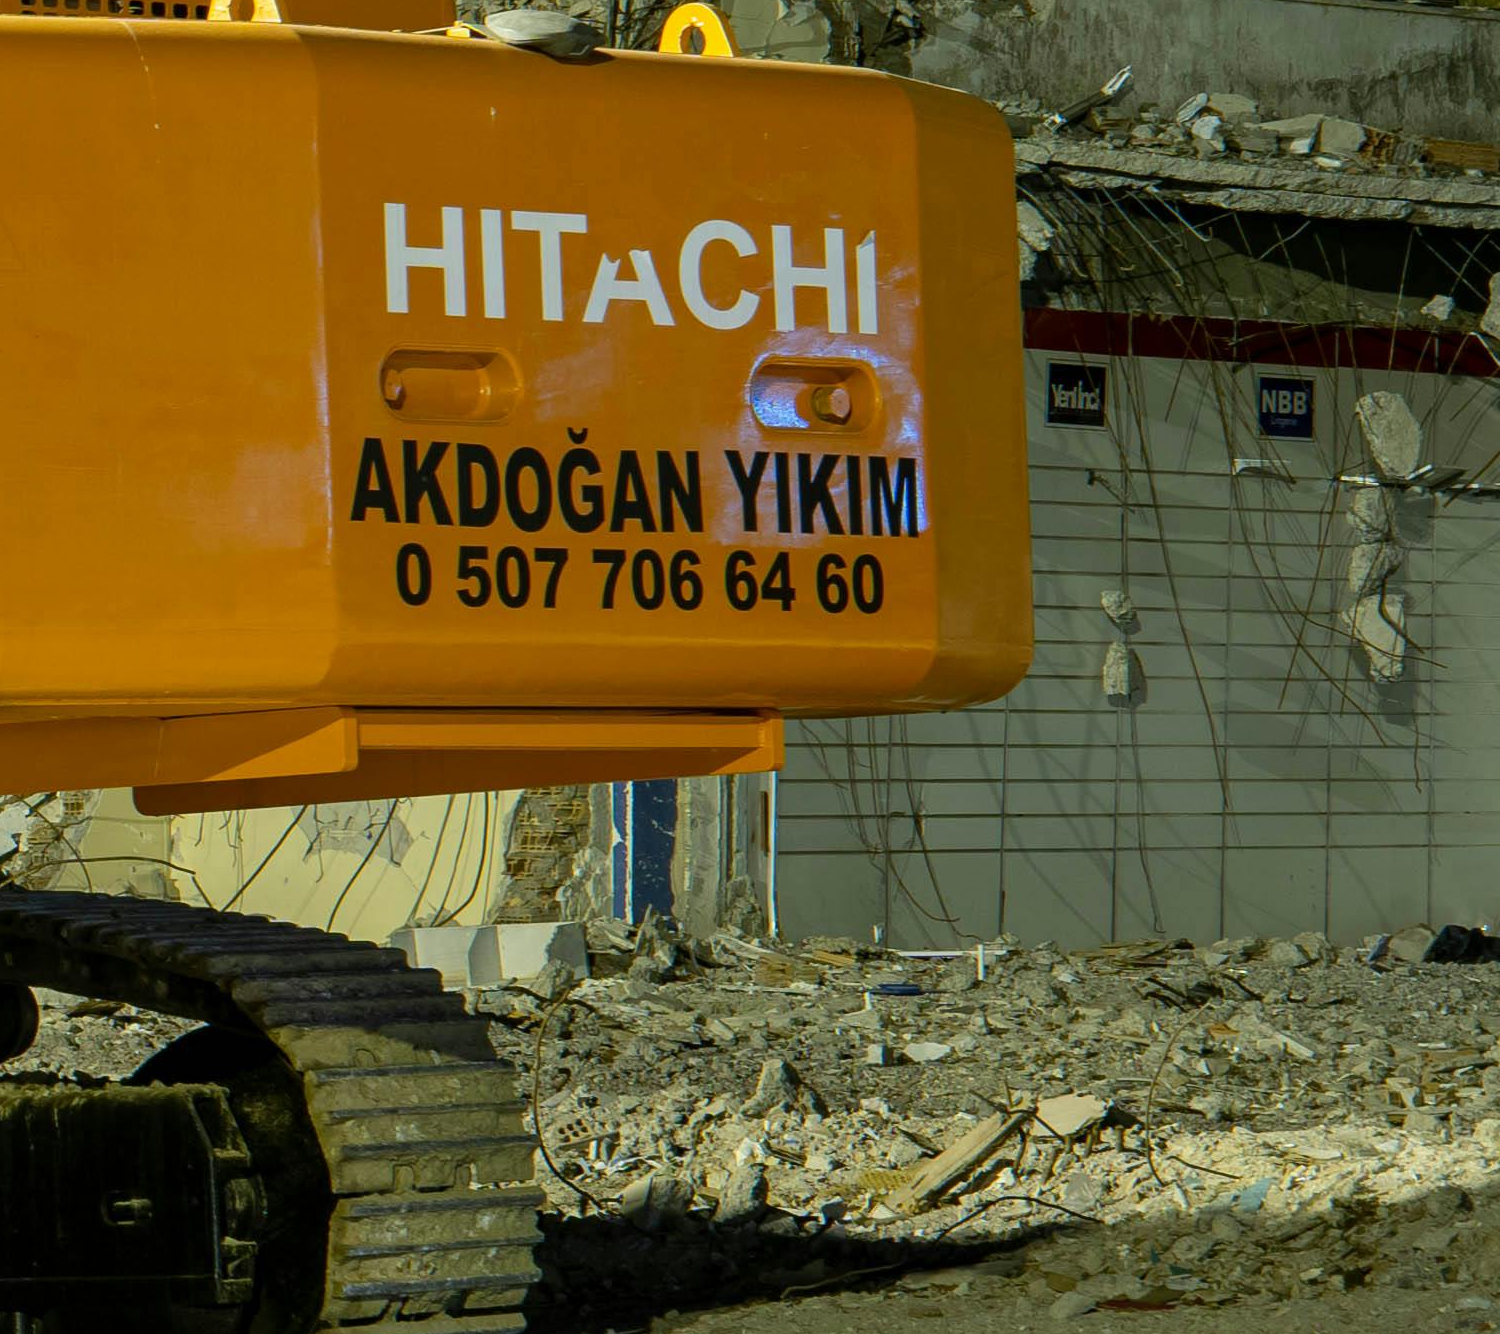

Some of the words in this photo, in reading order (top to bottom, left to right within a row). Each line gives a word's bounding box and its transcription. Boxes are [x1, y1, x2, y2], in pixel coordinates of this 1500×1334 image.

[383, 202, 878, 335] HITACHI
[1261, 389, 1308, 415] NBB
[350, 427, 704, 534] AKDOĞAN
[724, 449, 920, 538] YIKIM
[396, 542, 432, 607] 0
[456, 545, 569, 609] 507
[592, 547, 704, 611] 706
[724, 550, 796, 612] 64
[816, 553, 884, 614] 60
